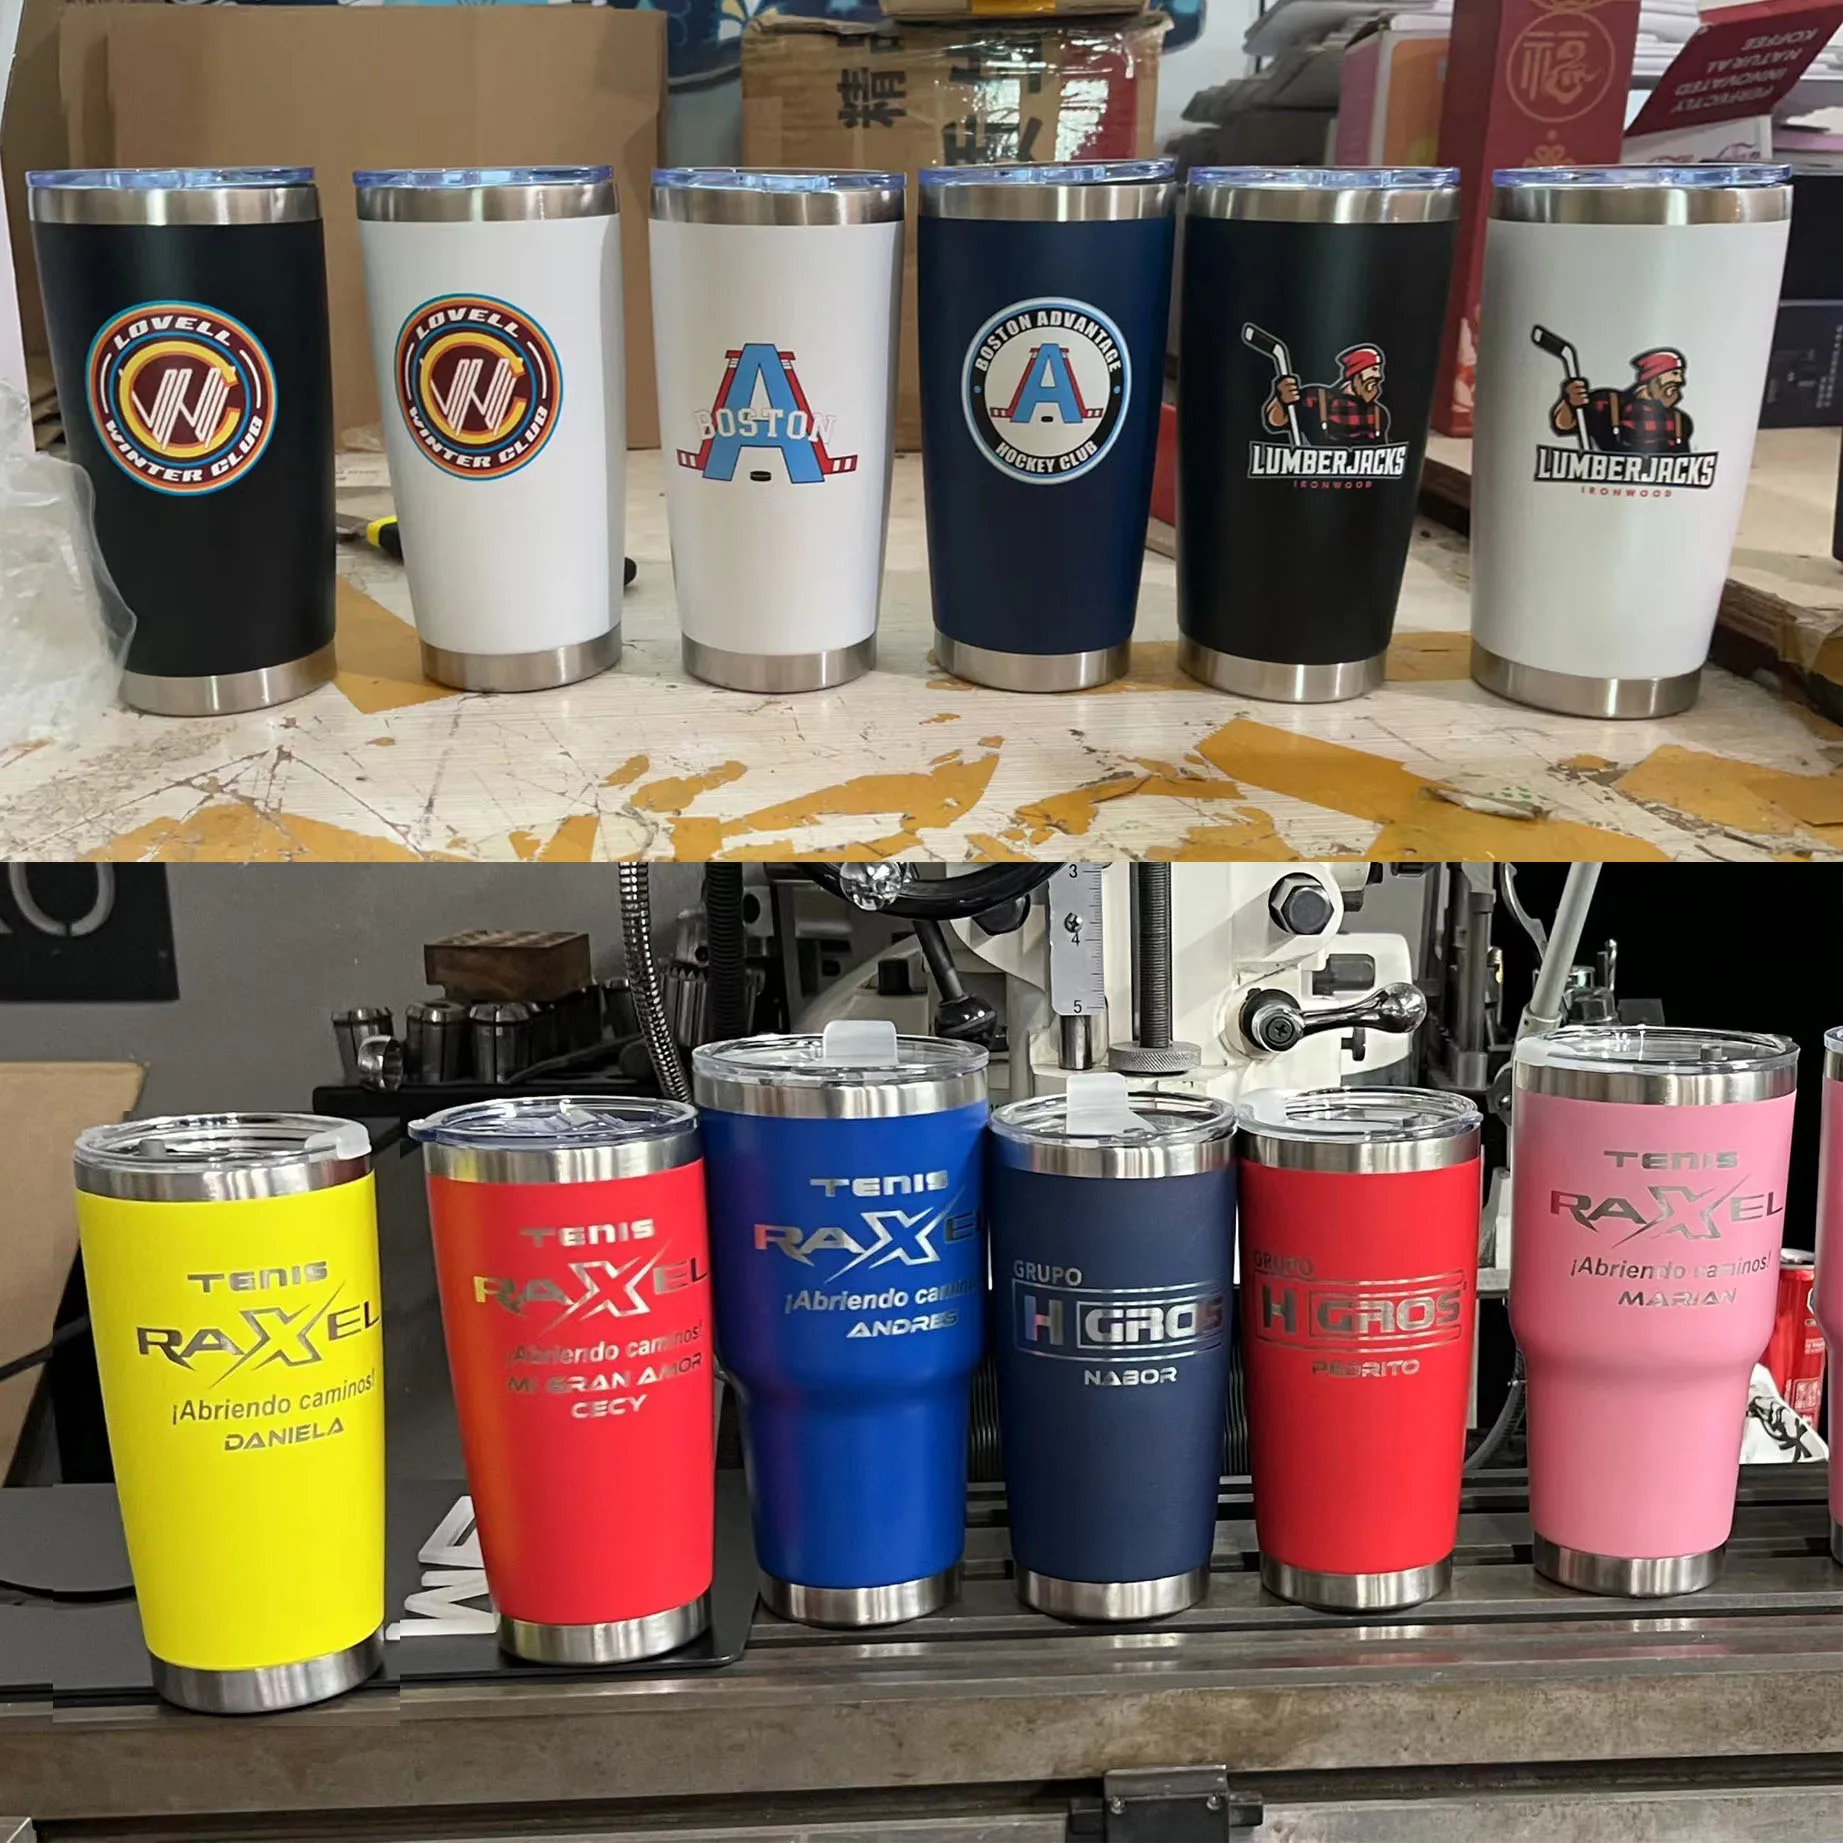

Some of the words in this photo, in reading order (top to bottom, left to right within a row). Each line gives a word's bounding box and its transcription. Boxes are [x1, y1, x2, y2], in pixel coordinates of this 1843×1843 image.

[1707, 48, 1802, 73] NATURAL
[113, 315, 232, 351] LOVELL
[415, 307, 519, 340] LOVELL
[974, 313, 1033, 372] BOSTON
[1036, 310, 1122, 373] ADVANTAGE
[408, 406, 492, 468] WINTER
[498, 405, 548, 464] CLUB
[693, 407, 838, 445] BOSTON
[105, 419, 203, 483] WINTER
[210, 415, 263, 477] CLUB
[995, 441, 1056, 474] HOCKEY
[1058, 440, 1098, 471] CLUB
[1250, 444, 1408, 476] LUMBERJACKS
[1537, 448, 1716, 487] LUMBERJACKS
[1293, 480, 1373, 490] IRONWOOD
[1580, 486, 1672, 498] IRONWOOD
[1069, 863, 1078, 879] 3
[1071, 931, 1080, 947] 4
[1073, 999, 1082, 1014] 5
[1604, 1150, 1738, 1170] TENIS
[809, 1169, 948, 1198] TENIS
[1550, 1173, 1784, 1249] RAXEL
[519, 1218, 655, 1248] TENIS
[187, 1260, 328, 1293] TENIS
[473, 1239, 709, 1337] RAXEL
[1013, 1259, 1083, 1286] GRUPO
[1262, 1283, 1297, 1336] H
[1316, 1288, 1462, 1334] GROS
[1618, 1288, 1737, 1307] MARIAN
[136, 1280, 380, 1389] RAXEL
[846, 1307, 960, 1339] ANDRES
[1024, 1294, 1064, 1346] H
[1085, 1296, 1224, 1344] GROS
[546, 1370, 630, 1395] GRAN
[637, 1352, 703, 1387] AMOR
[1083, 1365, 1178, 1387] NABOR
[172, 1393, 292, 1426] ¡Abriendo
[299, 1367, 375, 1411] caminos!
[571, 1394, 648, 1420] CECY
[224, 1417, 345, 1452] DANIELA
